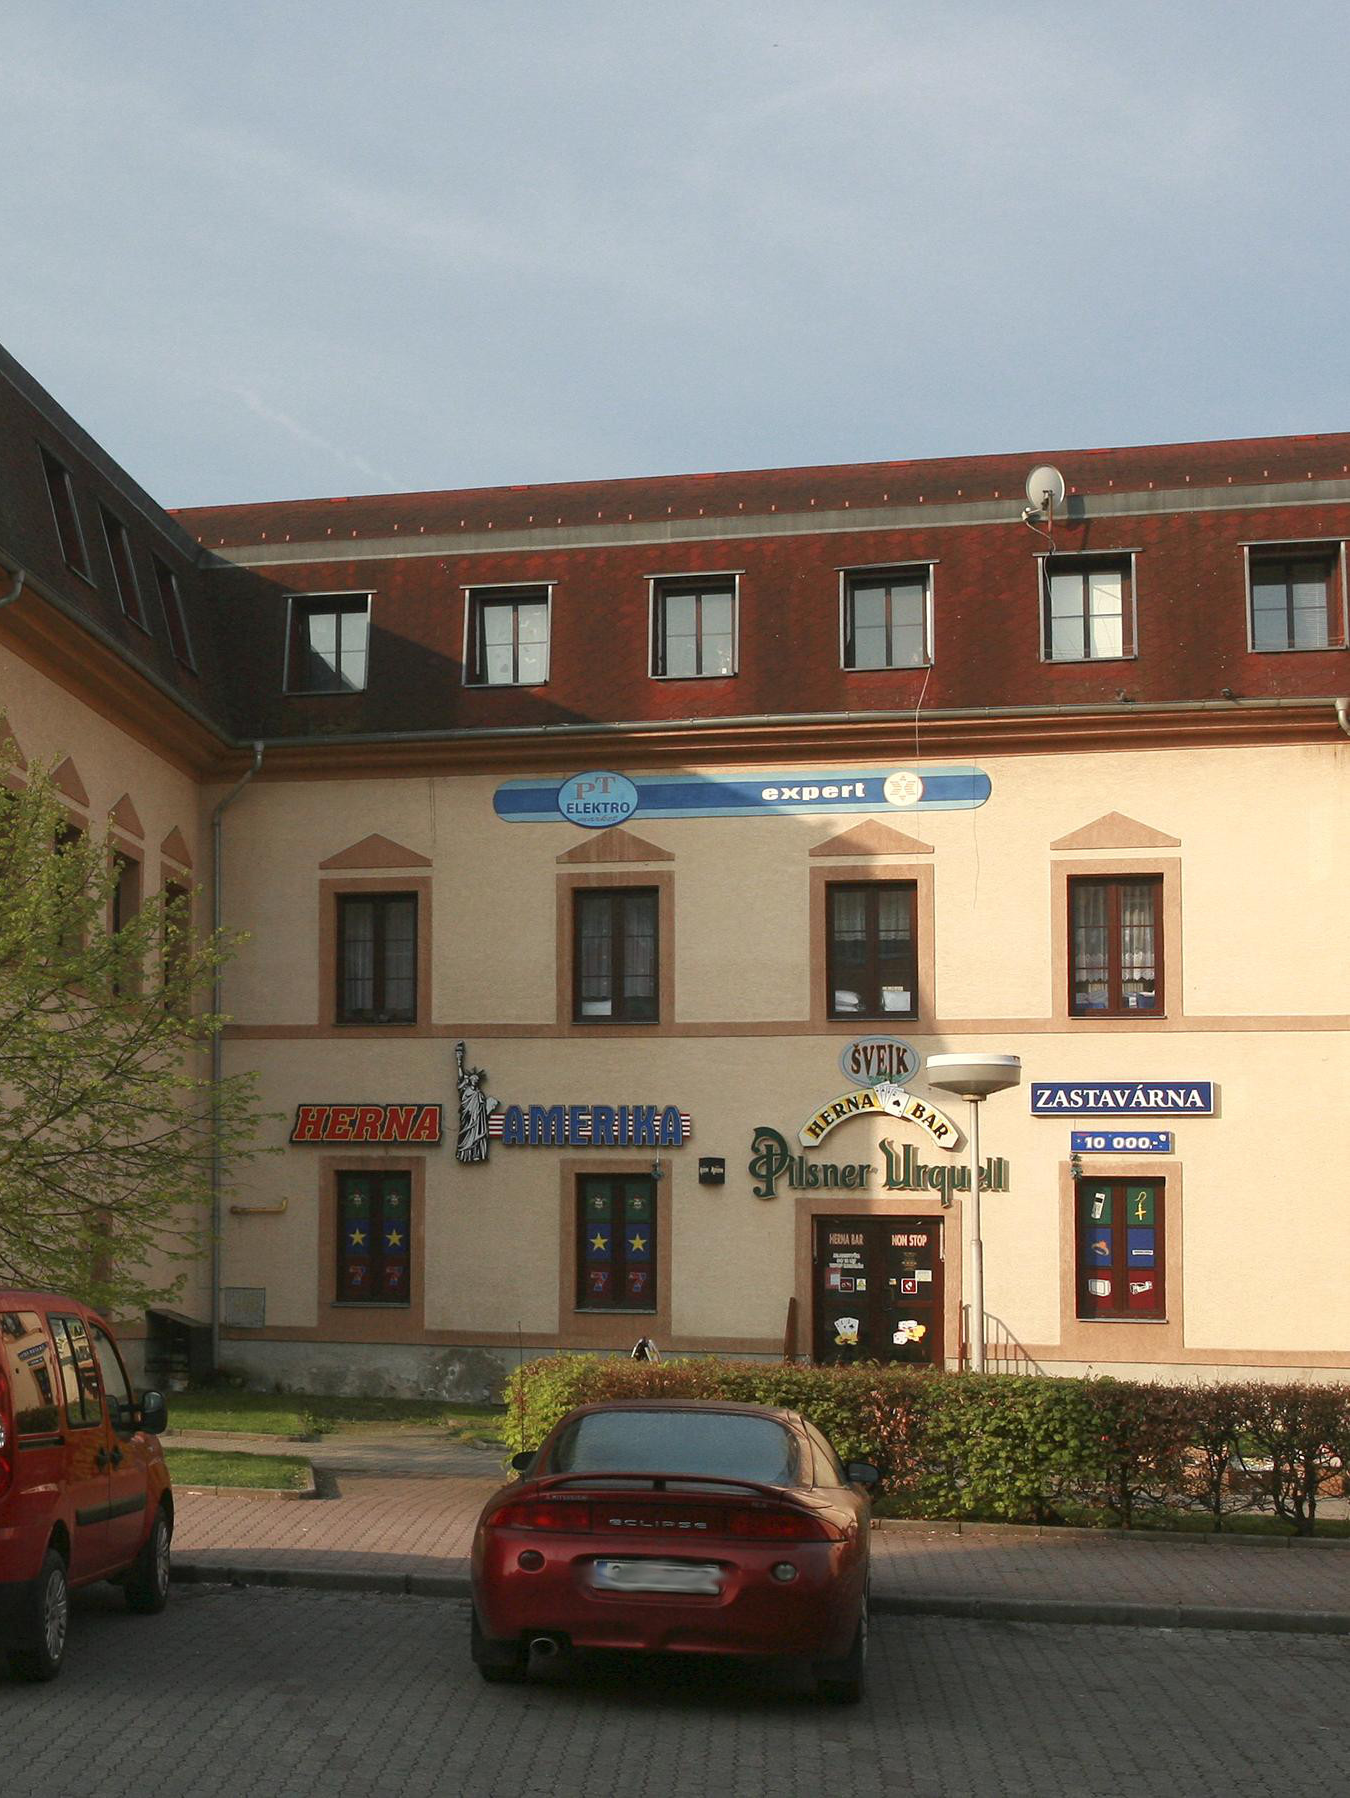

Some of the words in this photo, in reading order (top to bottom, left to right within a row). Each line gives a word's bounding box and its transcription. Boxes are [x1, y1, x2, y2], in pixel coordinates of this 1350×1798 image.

[574, 775, 617, 800] PT
[762, 782, 865, 801] expert
[566, 801, 630, 814] ELEKTRO
[851, 1043, 909, 1080] ŠVEJK
[1036, 1084, 1204, 1108] ZASTAVÁRNA
[293, 1105, 441, 1143] HERNA
[502, 1104, 683, 1146] AMERIKA
[806, 1093, 875, 1140] HERNA
[910, 1102, 949, 1140] BAR
[1084, 1136, 1105, 1149] 10
[1112, 1136, 1158, 1151] 000,-
[748, 1126, 871, 1199] Pilsner
[878, 1137, 1004, 1209] Urquell
[829, 1233, 850, 1245] HERNA
[851, 1233, 864, 1246] BAR
[891, 1234, 908, 1246] NON
[908, 1234, 928, 1246] STOP
